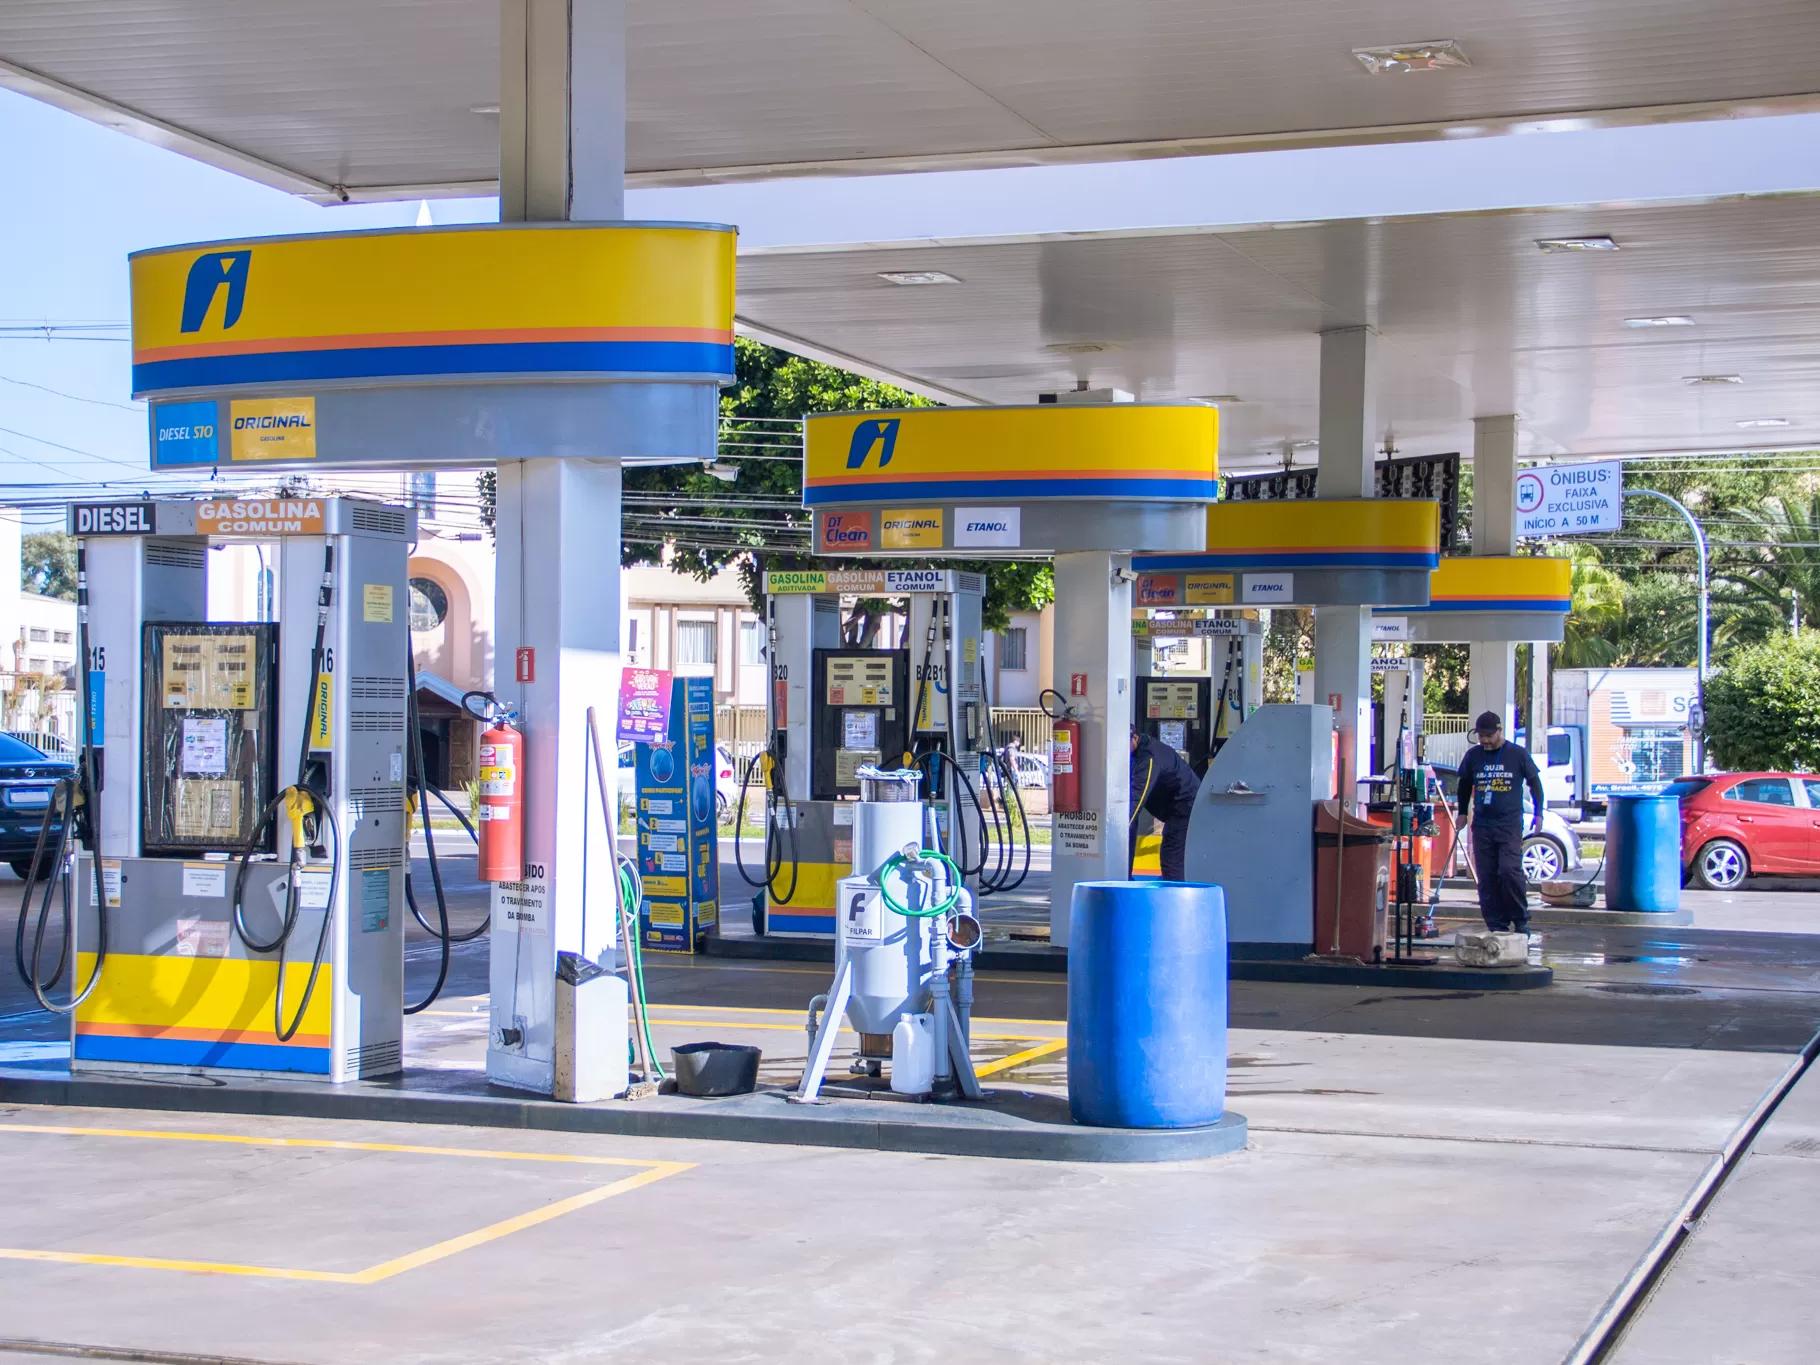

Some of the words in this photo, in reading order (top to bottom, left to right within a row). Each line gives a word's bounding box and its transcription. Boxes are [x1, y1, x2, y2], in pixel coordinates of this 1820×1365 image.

[234, 415, 311, 430] ORIGINAL
[159, 427, 190, 441] DIESEL
[1565, 487, 1597, 498] FAIXA
[199, 502, 320, 519] GASOLINA
[1548, 499, 1608, 513] EXCLUSIVA
[78, 507, 150, 532] DIESEL
[828, 516, 843, 528] DT
[884, 520, 940, 529] ORIGINAL
[1524, 517, 1555, 529] INÍCIO
[1562, 517, 1569, 527] A
[1576, 516, 1588, 525] 50
[1591, 515, 1599, 524] M
[218, 521, 301, 532] COMUM
[966, 522, 1008, 531] ETANOL
[826, 528, 868, 542] Clean
[769, 573, 825, 584] GASOLINA
[828, 572, 883, 583] GASOLINA
[887, 572, 943, 582] ETANOL
[1252, 584, 1284, 592] ETANOL
[1150, 620, 1192, 628] GASOLINA
[1195, 620, 1237, 628] ETANOL
[320, 681, 328, 739] ORIGINAL
[499, 881, 529, 892] ABASTECER
[501, 896, 505, 904] O
[507, 896, 542, 908] TRAVAMENTO
[508, 911, 515, 919] DA
[516, 912, 535, 921] BOMBA
[850, 927, 873, 935] FILPAR
